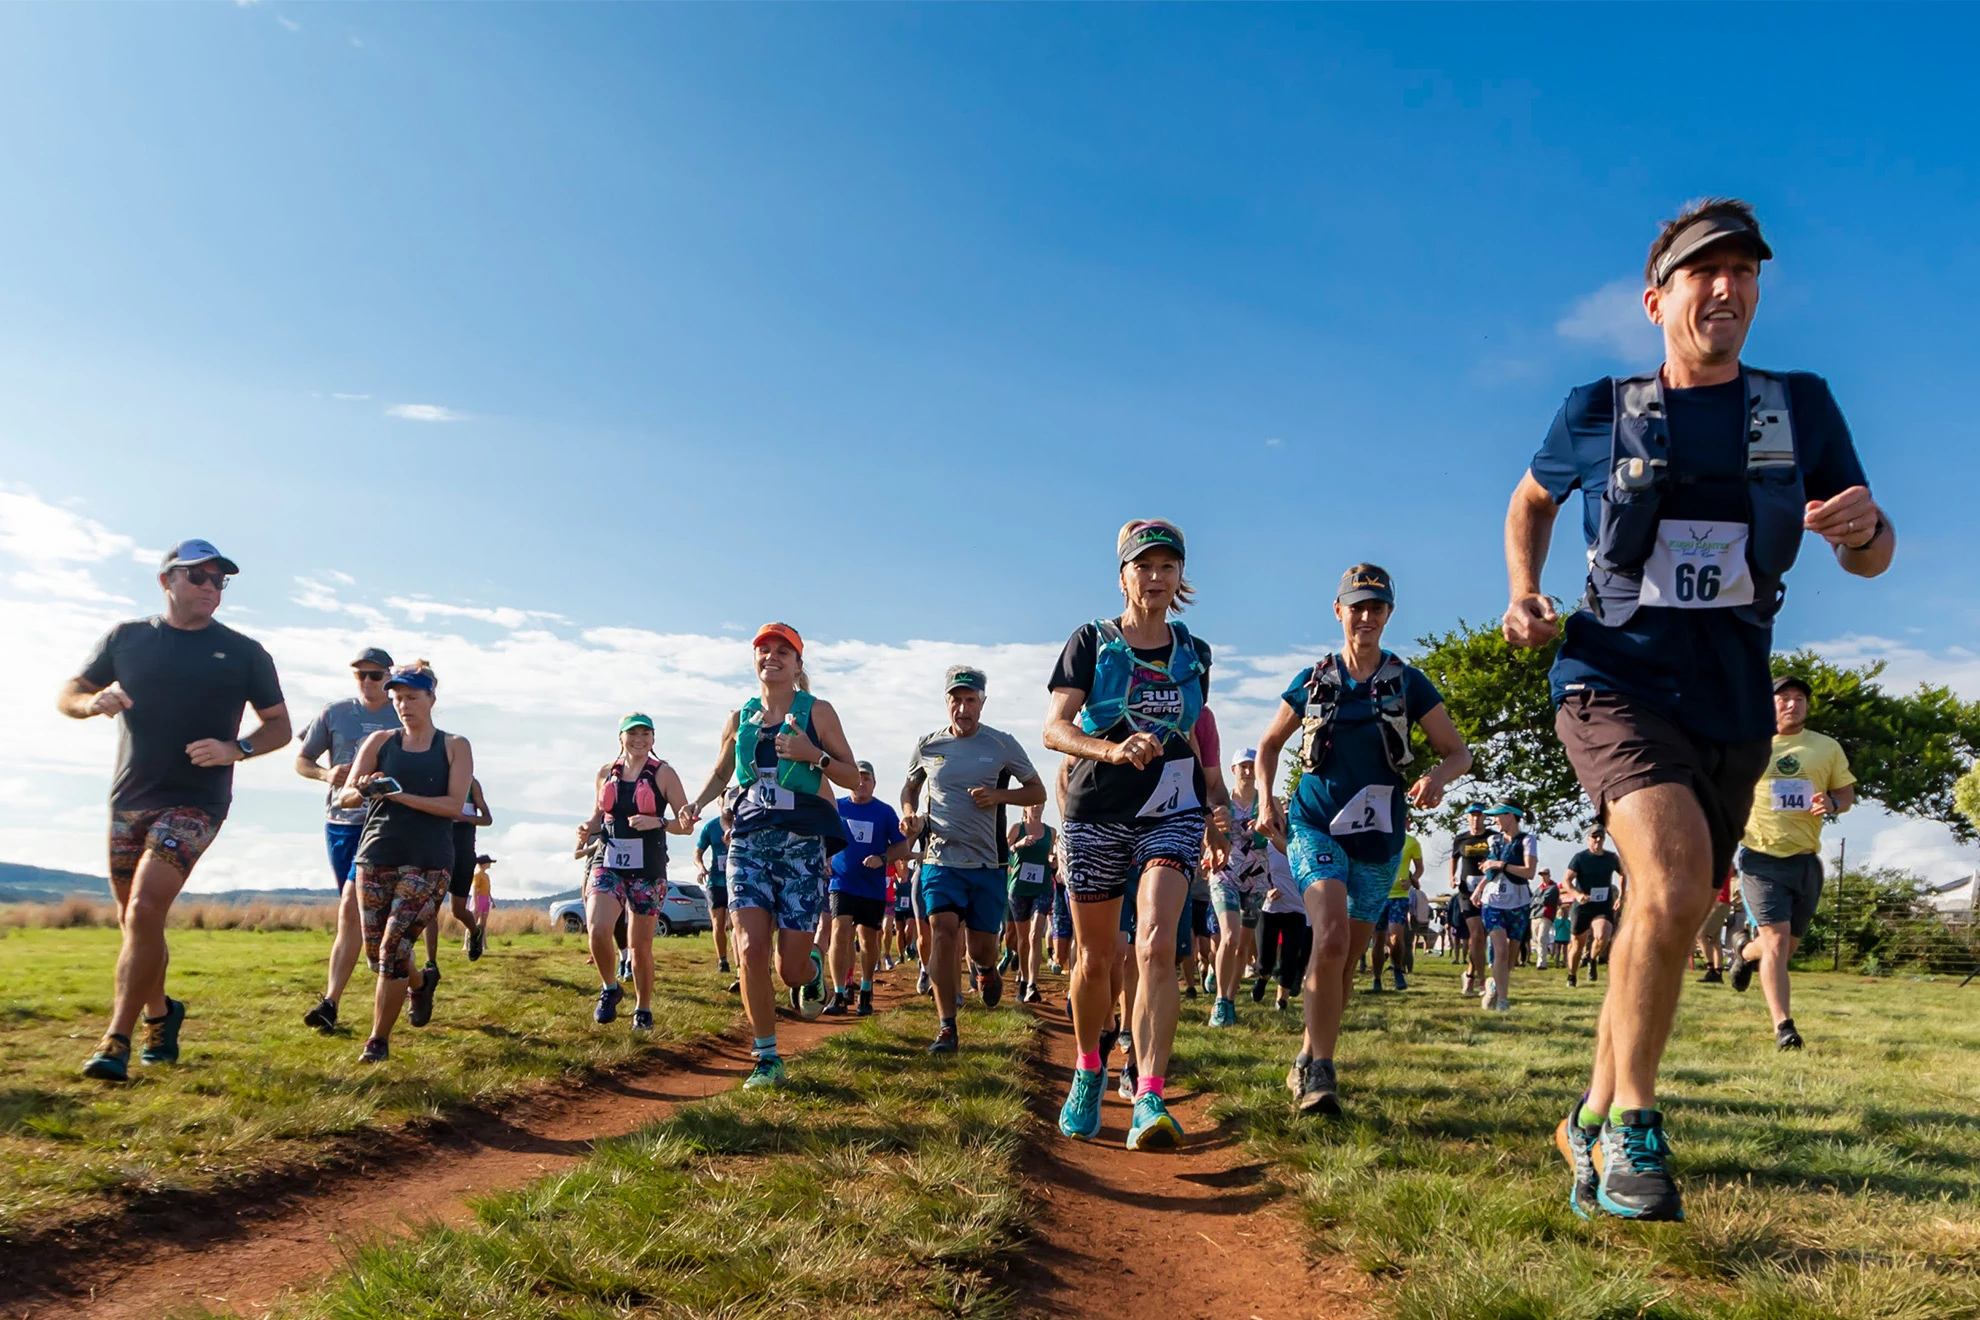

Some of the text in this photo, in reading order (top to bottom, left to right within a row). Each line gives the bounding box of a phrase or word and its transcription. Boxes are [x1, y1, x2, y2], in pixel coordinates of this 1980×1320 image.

[1675, 562, 1722, 602] 66
[1780, 794, 1805, 809] 144
[615, 853, 631, 867] 42
[1026, 871, 1036, 881] 24
[1069, 890, 1109, 901] OUTRUN
